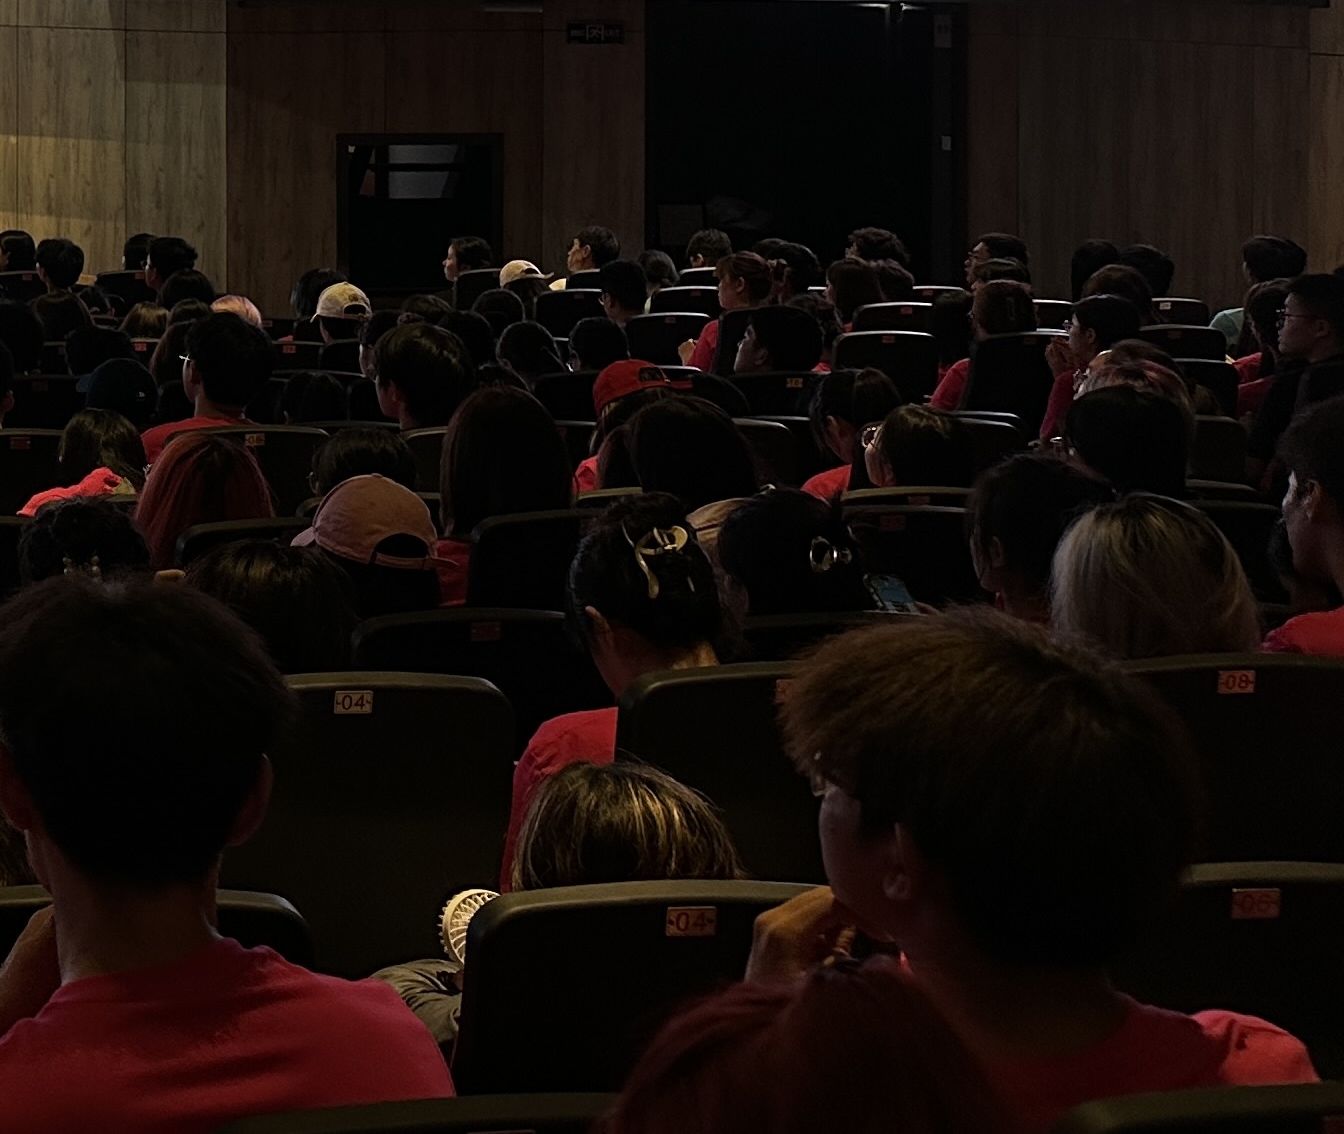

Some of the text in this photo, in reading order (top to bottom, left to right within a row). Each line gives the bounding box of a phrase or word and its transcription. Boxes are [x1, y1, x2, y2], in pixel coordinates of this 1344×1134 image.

[1225, 674, 1249, 690] 08
[341, 694, 365, 710] 04
[675, 911, 706, 932] 04
